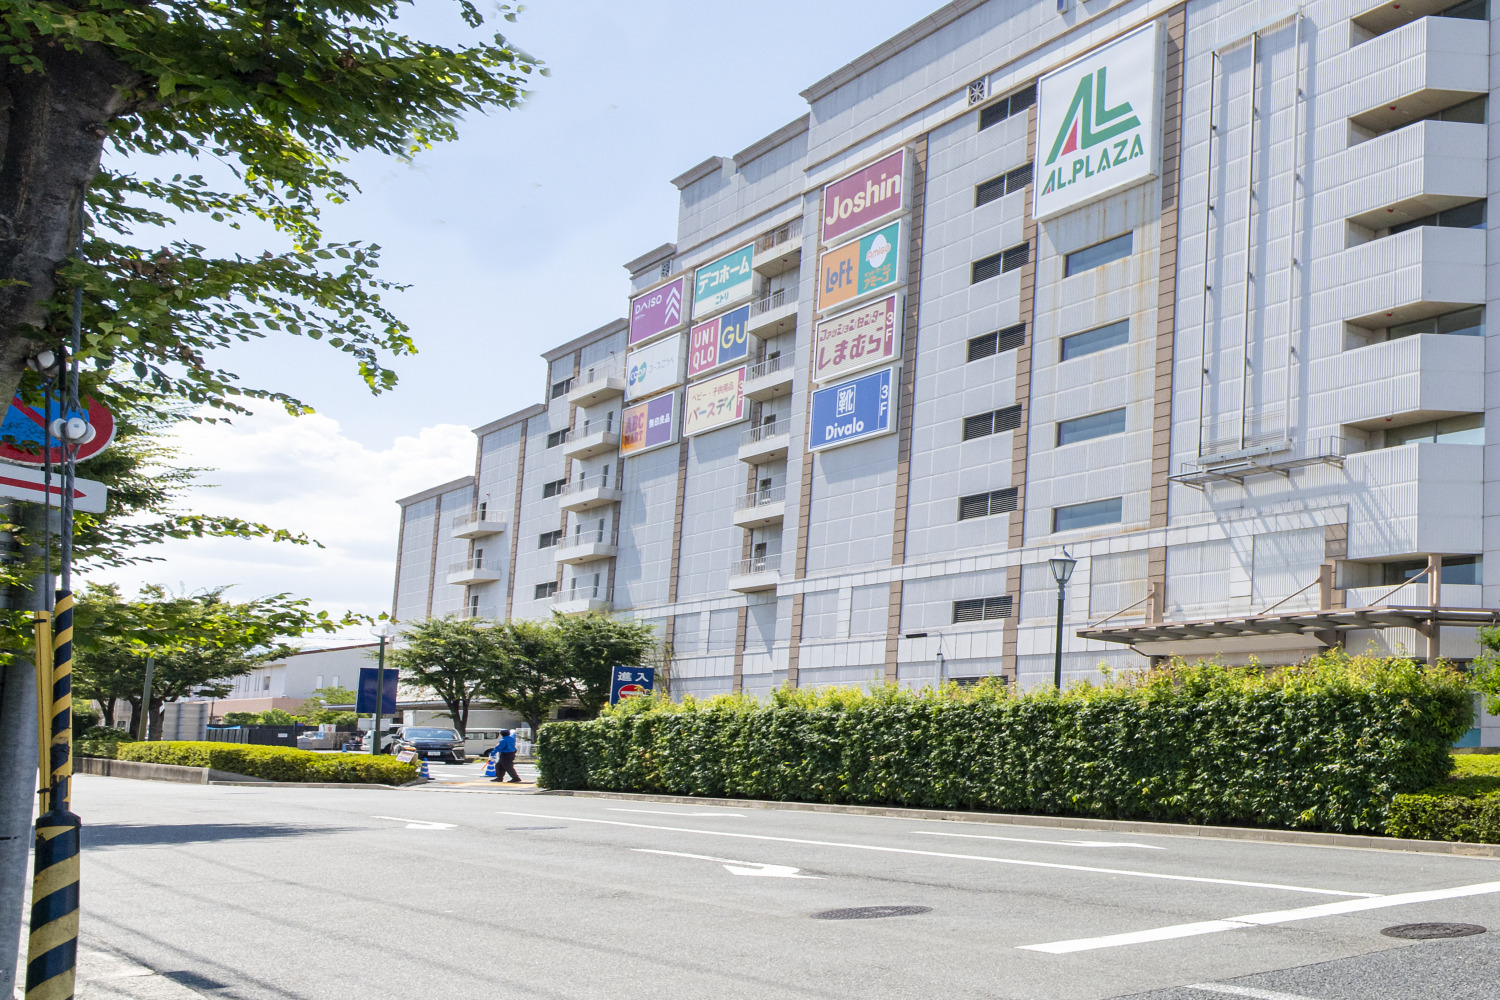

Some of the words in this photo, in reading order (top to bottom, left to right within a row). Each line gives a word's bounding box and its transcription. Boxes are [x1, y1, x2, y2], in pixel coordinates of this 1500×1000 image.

[1041, 134, 1144, 196] AL.PLAZA
[826, 173, 900, 225] Joshin
[699, 256, 749, 294] デコホーム
[635, 294, 663, 315] DAISO
[694, 326, 714, 348] UNI
[721, 321, 748, 349] GU
[819, 310, 885, 342] ファッションセンター
[886, 312, 894, 342] 3F
[693, 346, 714, 370] QLO
[818, 326, 884, 370] しまむら
[880, 385, 888, 416] 3F
[825, 417, 864, 441] Divalo
[617, 671, 650, 683] 進入
